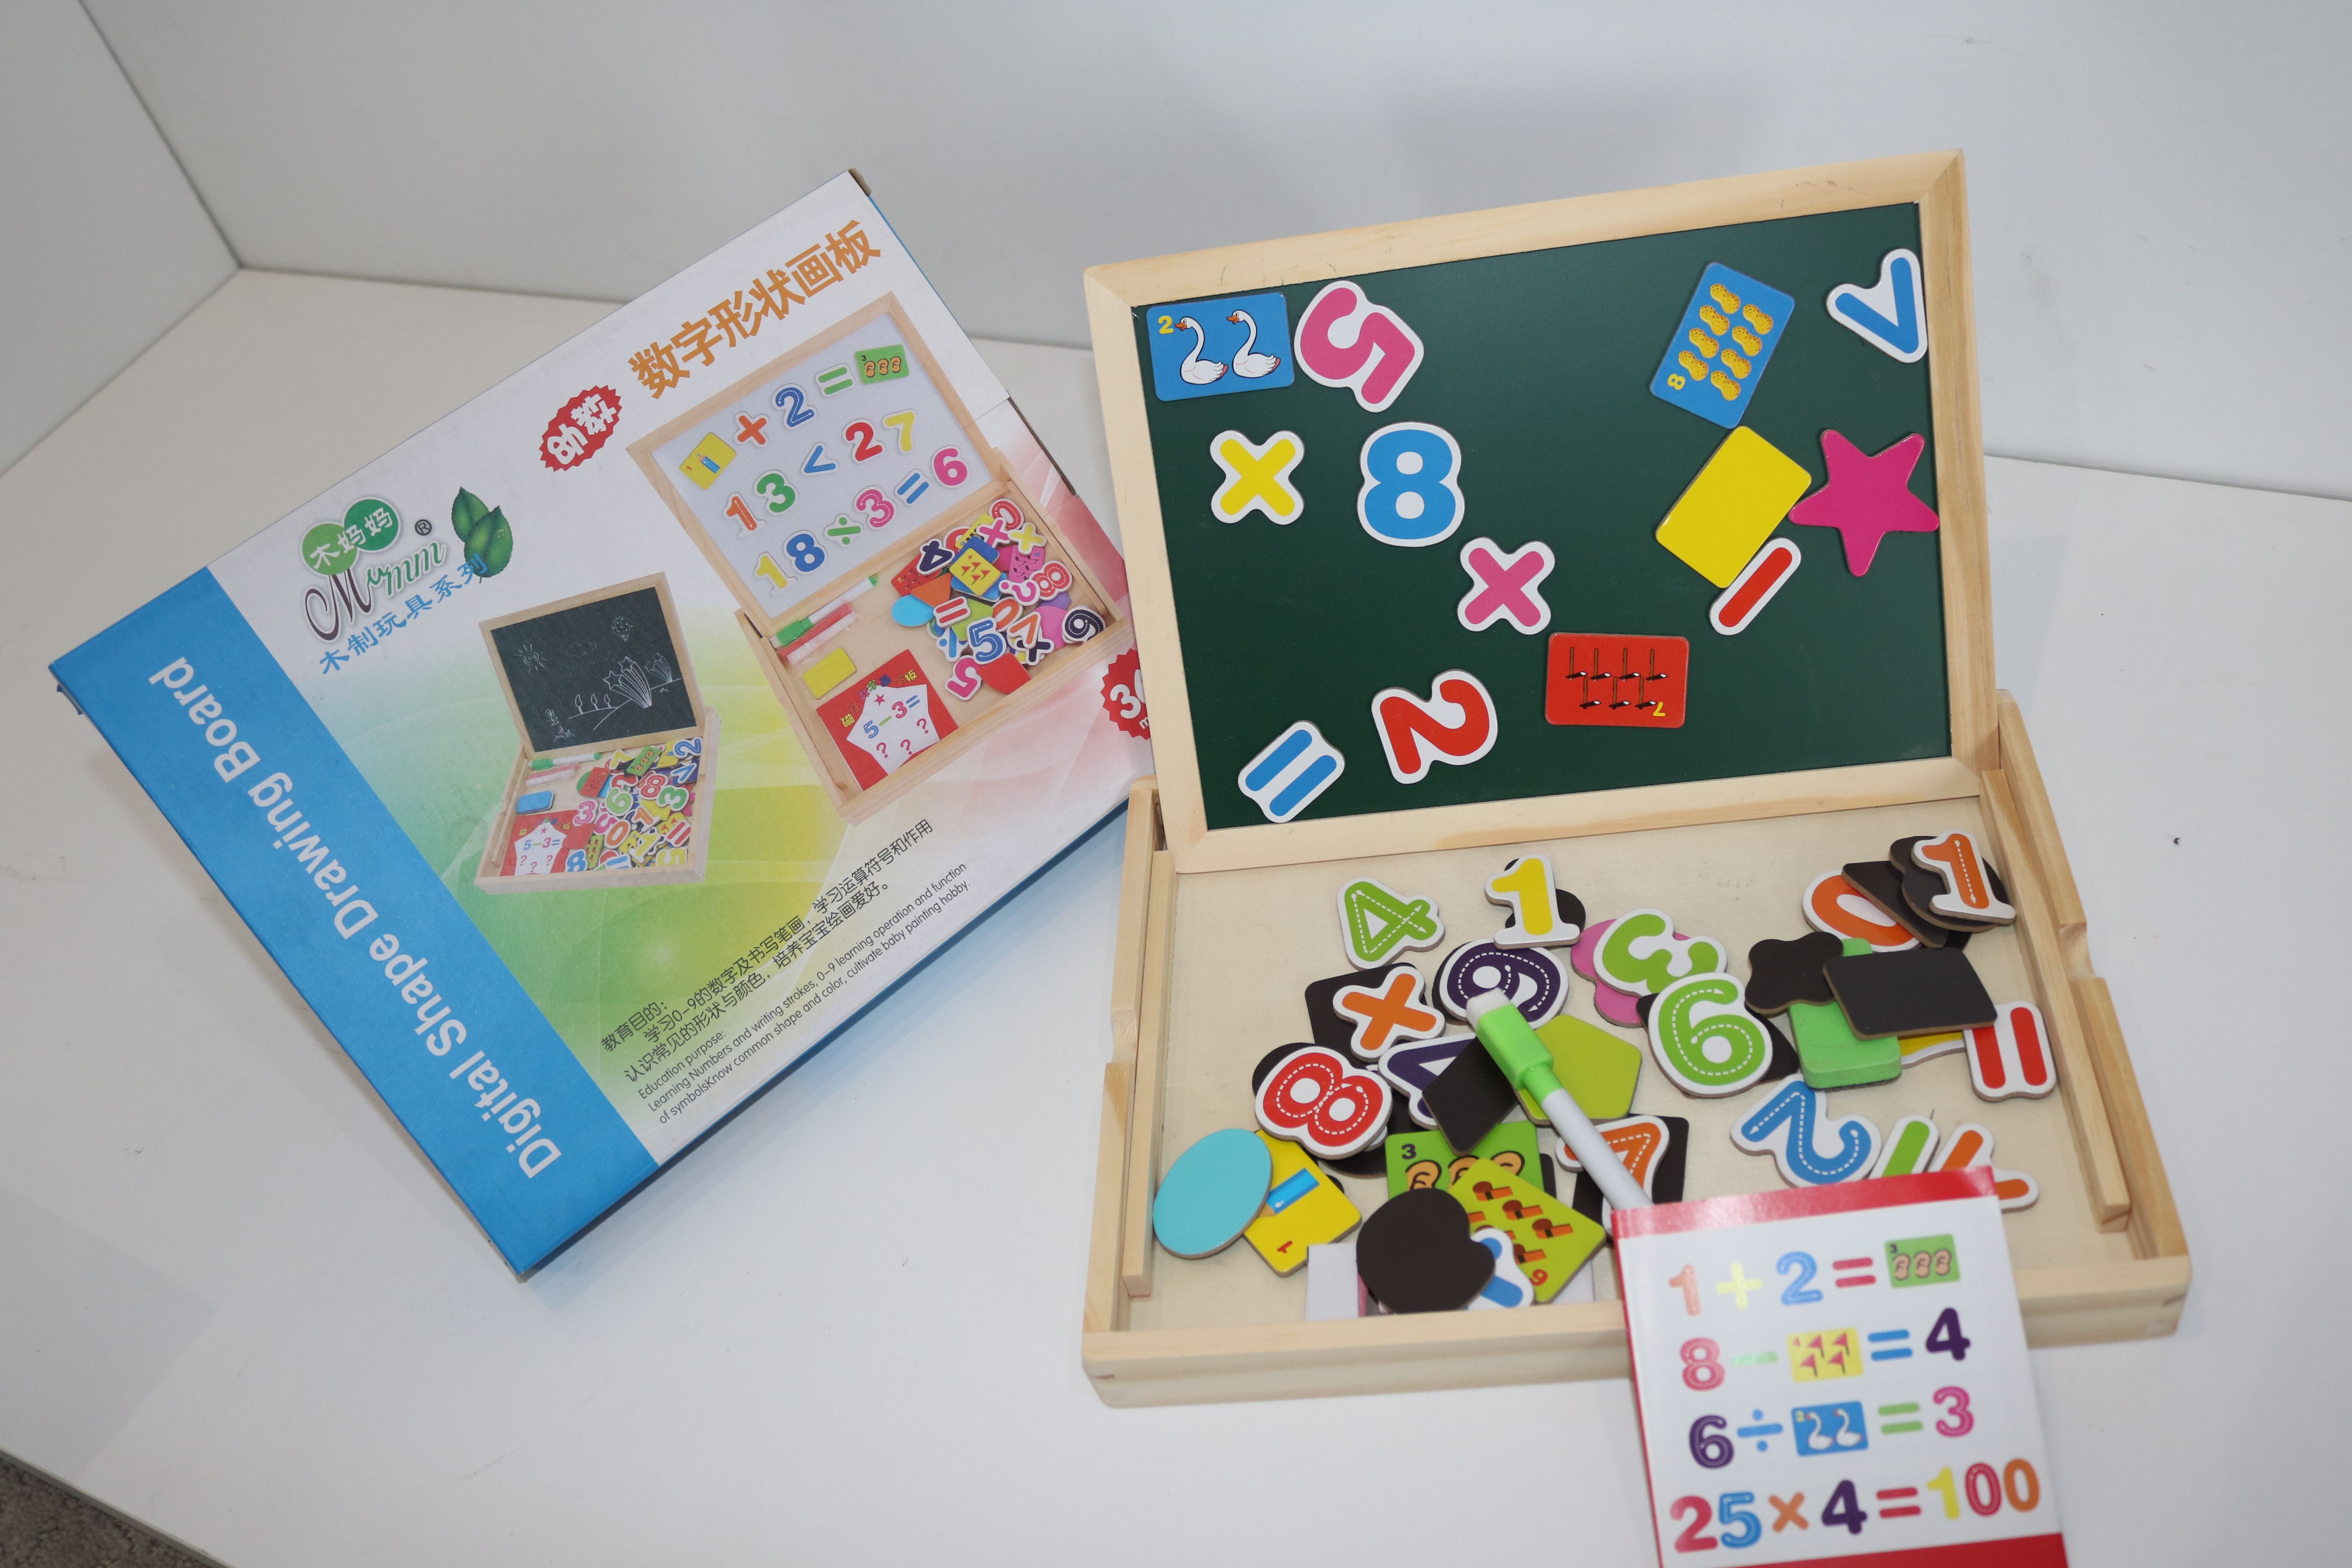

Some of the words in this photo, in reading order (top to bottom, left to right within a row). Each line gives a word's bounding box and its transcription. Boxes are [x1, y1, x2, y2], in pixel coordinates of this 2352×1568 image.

[628, 220, 881, 399] 数字形状画板
[1158, 315, 1174, 334] 2
[1300, 287, 1415, 404] 5
[775, 387, 814, 427] 2
[1667, 373, 1685, 390] 8
[857, 489, 894, 527] 3
[934, 448, 967, 486] 6
[1364, 429, 1456, 539] 8
[310, 508, 392, 569] 木妈妈
[319, 553, 487, 674] 木制玩具系列
[969, 620, 1004, 662] 5
[149, 657, 260, 784] Board
[1379, 679, 1490, 774] 2
[573, 801, 595, 823] 3
[641, 776, 666, 797] 8
[247, 772, 378, 940] Drawing
[1922, 833, 1989, 909] 1
[1345, 882, 1437, 962] 4
[1492, 858, 1553, 935] 1
[368, 933, 467, 1057] Shape
[648, 1077, 691, 1112] Learning
[689, 1045, 733, 1081] Numbers
[733, 1028, 752, 1047] and
[751, 1005, 784, 1033] writing
[783, 979, 818, 1008] strokes,
[834, 935, 874, 967] learning
[873, 904, 915, 941] operation
[915, 888, 933, 906] and
[931, 864, 967, 893] function
[660, 1111, 671, 1123] of
[670, 1064, 733, 1118] symbolsKnow
[734, 1033, 774, 1066] common
[774, 1010, 803, 1036] shape
[803, 993, 821, 1012] and
[822, 975, 847, 997] color,
[847, 949, 883, 978] cultivate
[881, 930, 906, 950] baby
[906, 903, 942, 934] painting
[940, 880, 971, 906] hobby.
[638, 1061, 685, 1099] Education
[685, 1031, 726, 1065] purpose:
[1658, 980, 1766, 1086] 6
[449, 1049, 562, 1178] Digital
[1263, 1053, 1383, 1147] 8
[1401, 1143, 1417, 1159] 3
[1777, 1251, 1823, 1305] 2
[1680, 1338, 1724, 1391] 8
[1926, 1307, 1970, 1361] 4
[1933, 1386, 1974, 1437] 3
